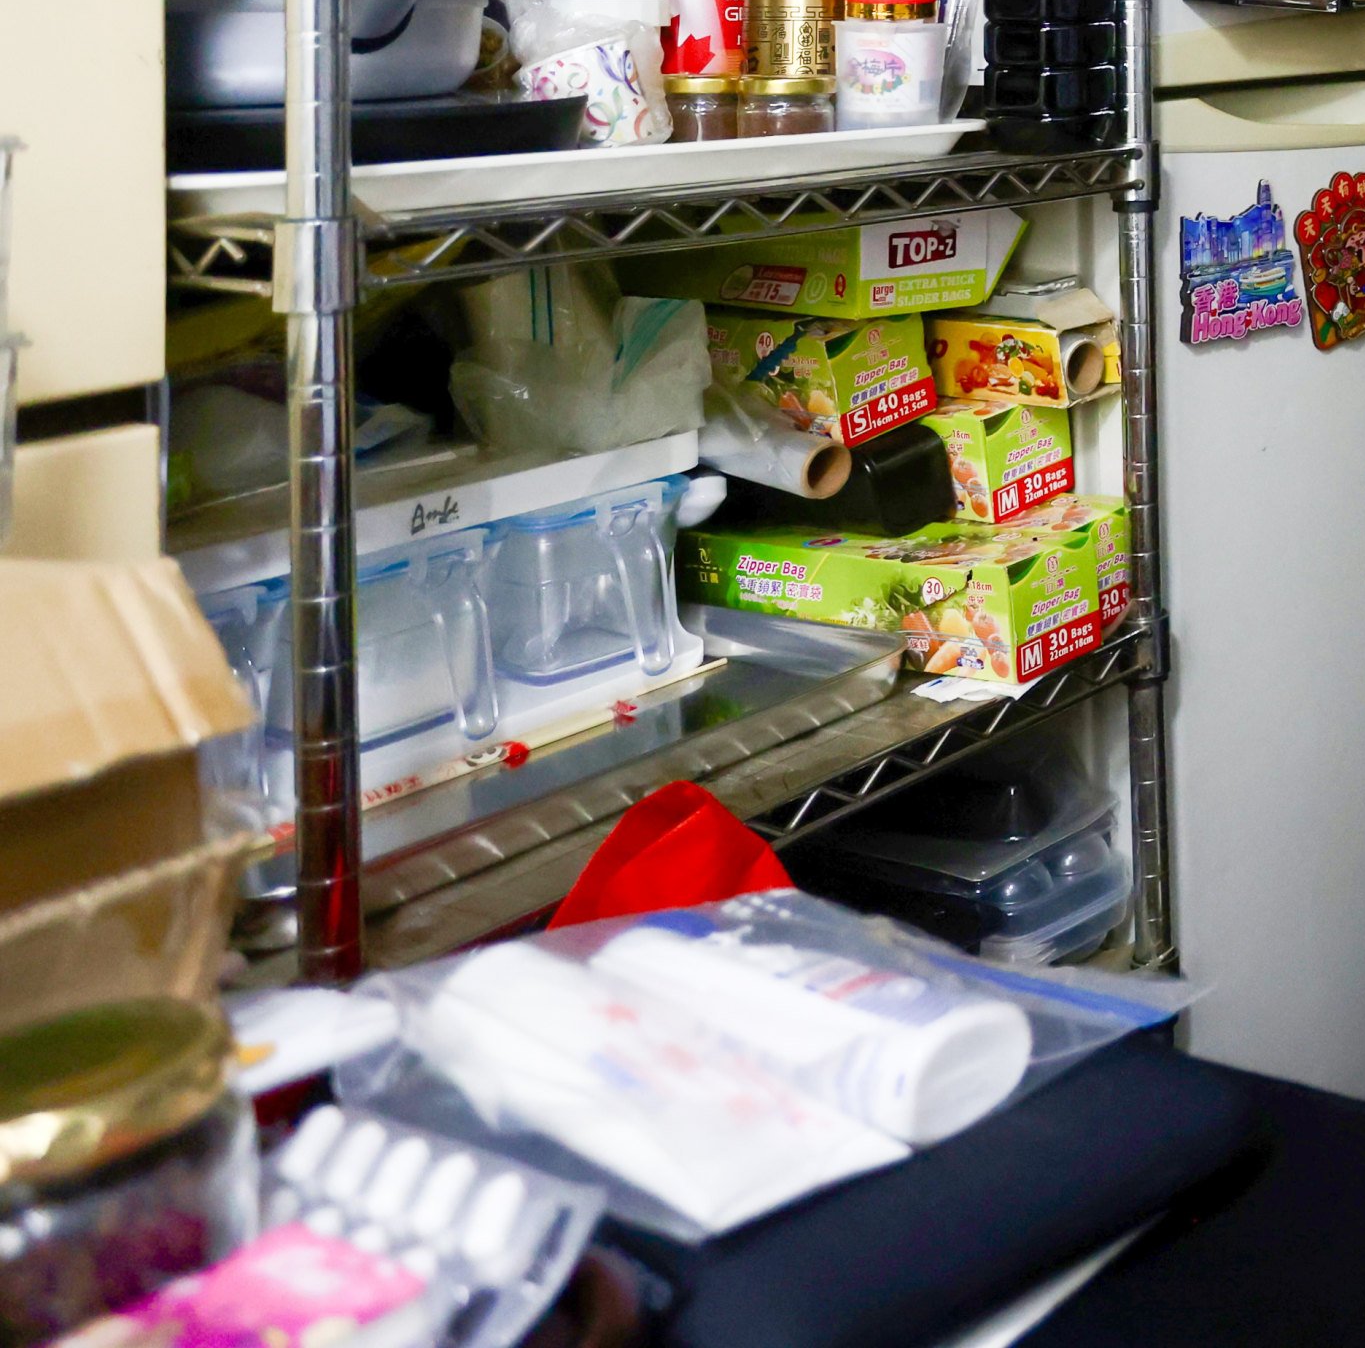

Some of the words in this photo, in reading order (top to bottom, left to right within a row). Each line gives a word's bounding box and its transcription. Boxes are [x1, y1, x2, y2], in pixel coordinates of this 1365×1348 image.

[796, 47, 812, 65] 福
[891, 237, 954, 266] TOP-Z
[763, 284, 779, 301] 15
[872, 285, 894, 302] Large
[898, 277, 938, 291] EXTRA
[940, 273, 976, 286] THICK
[897, 293, 939, 307] SLIDER
[942, 290, 972, 302] BAGS
[1193, 279, 1239, 316] 香港
[1191, 313, 1247, 344] Hong
[1250, 298, 1302, 330] Kong
[758, 334, 772, 347] 40
[854, 367, 886, 386] Zipper
[888, 356, 908, 371] Bag
[877, 393, 898, 413] 40
[902, 388, 927, 404] Bags
[853, 411, 867, 433] S
[871, 413, 893, 430] 16cm
[899, 398, 928, 418] 12.5cm
[1007, 445, 1034, 463] Zipper
[1036, 436, 1054, 450] Bag
[1024, 473, 1042, 493] 30
[1045, 466, 1067, 481] Bags
[1024, 489, 1044, 503] 22cm
[1049, 478, 1068, 493] 18cm
[1000, 486, 1018, 512] M
[736, 555, 779, 575] Zipper
[782, 561, 806, 580] Bag
[785, 582, 822, 601] 密實袋
[926, 581, 941, 596] 30
[1102, 589, 1119, 610] 20
[1031, 596, 1060, 616] Zipper
[1063, 587, 1080, 602] Bag
[1048, 628, 1068, 650] 30
[1071, 622, 1093, 638] Bags
[1024, 644, 1042, 671] M
[1049, 646, 1069, 662] 22cm
[1074, 636, 1094, 650] 18cm
